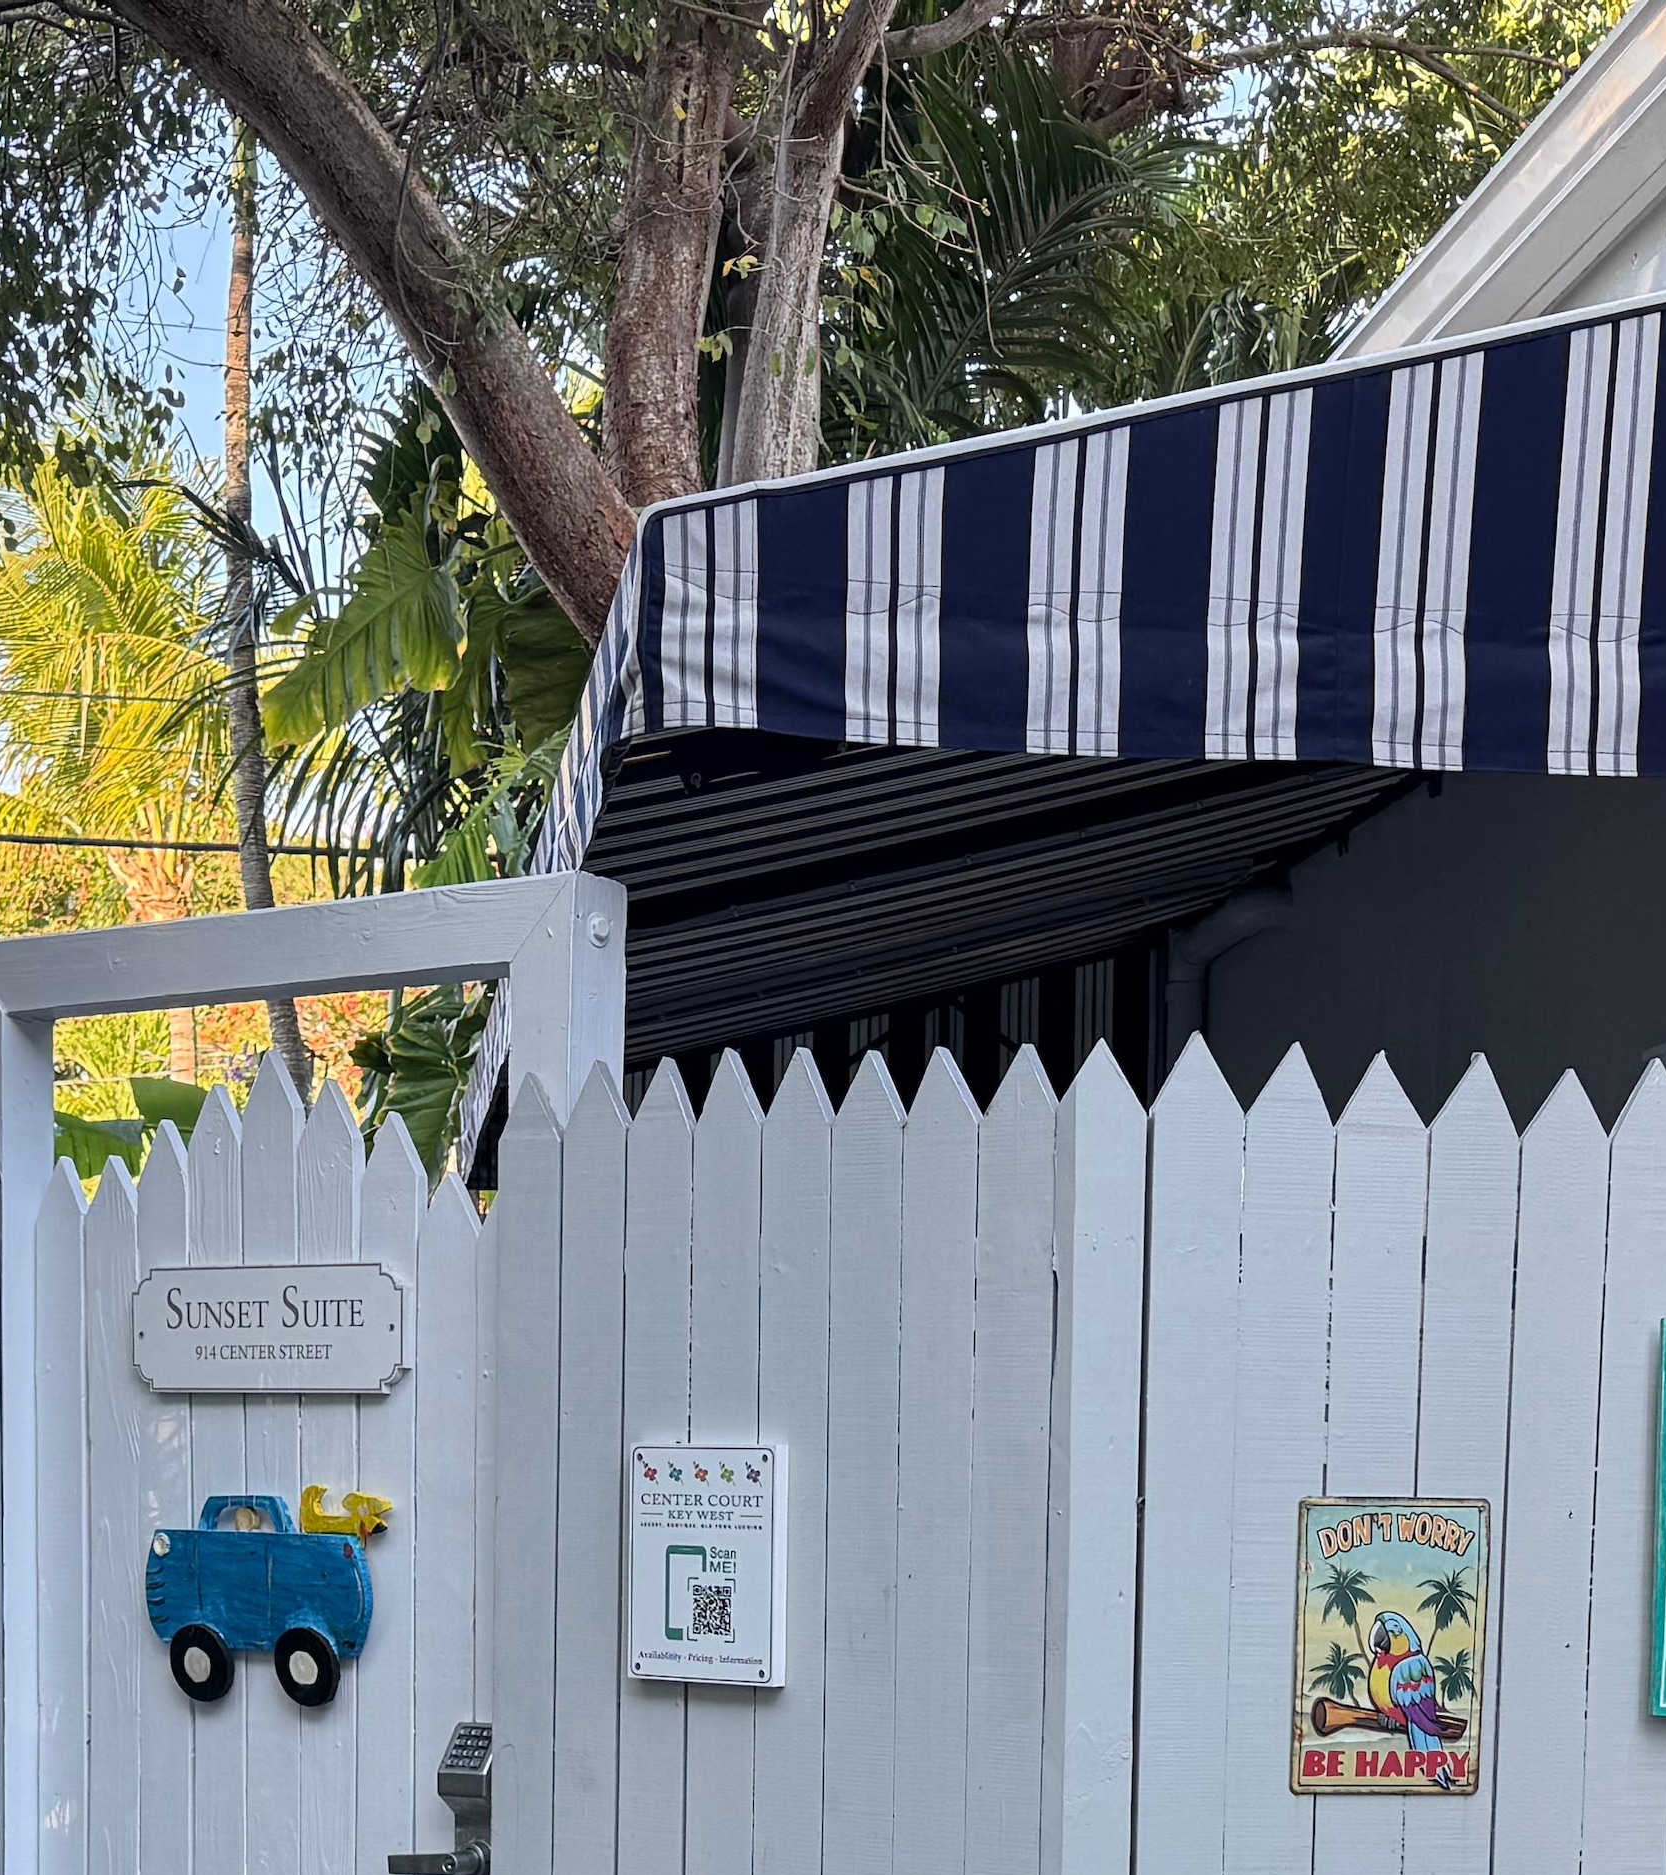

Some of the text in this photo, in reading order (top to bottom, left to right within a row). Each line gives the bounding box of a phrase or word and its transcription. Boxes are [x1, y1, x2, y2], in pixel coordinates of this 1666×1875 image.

[195, 1344, 333, 1360] 914 CENTER STREET
[641, 1493, 764, 1507] CENTER COURT
[668, 1510, 734, 1521] KEY WEST
[1317, 1512, 1476, 1560] DON'T WORRY
[710, 1546, 736, 1559] Scan
[687, 1653, 713, 1664] Pricing
[1302, 1750, 1470, 1777] BE HAPPY
